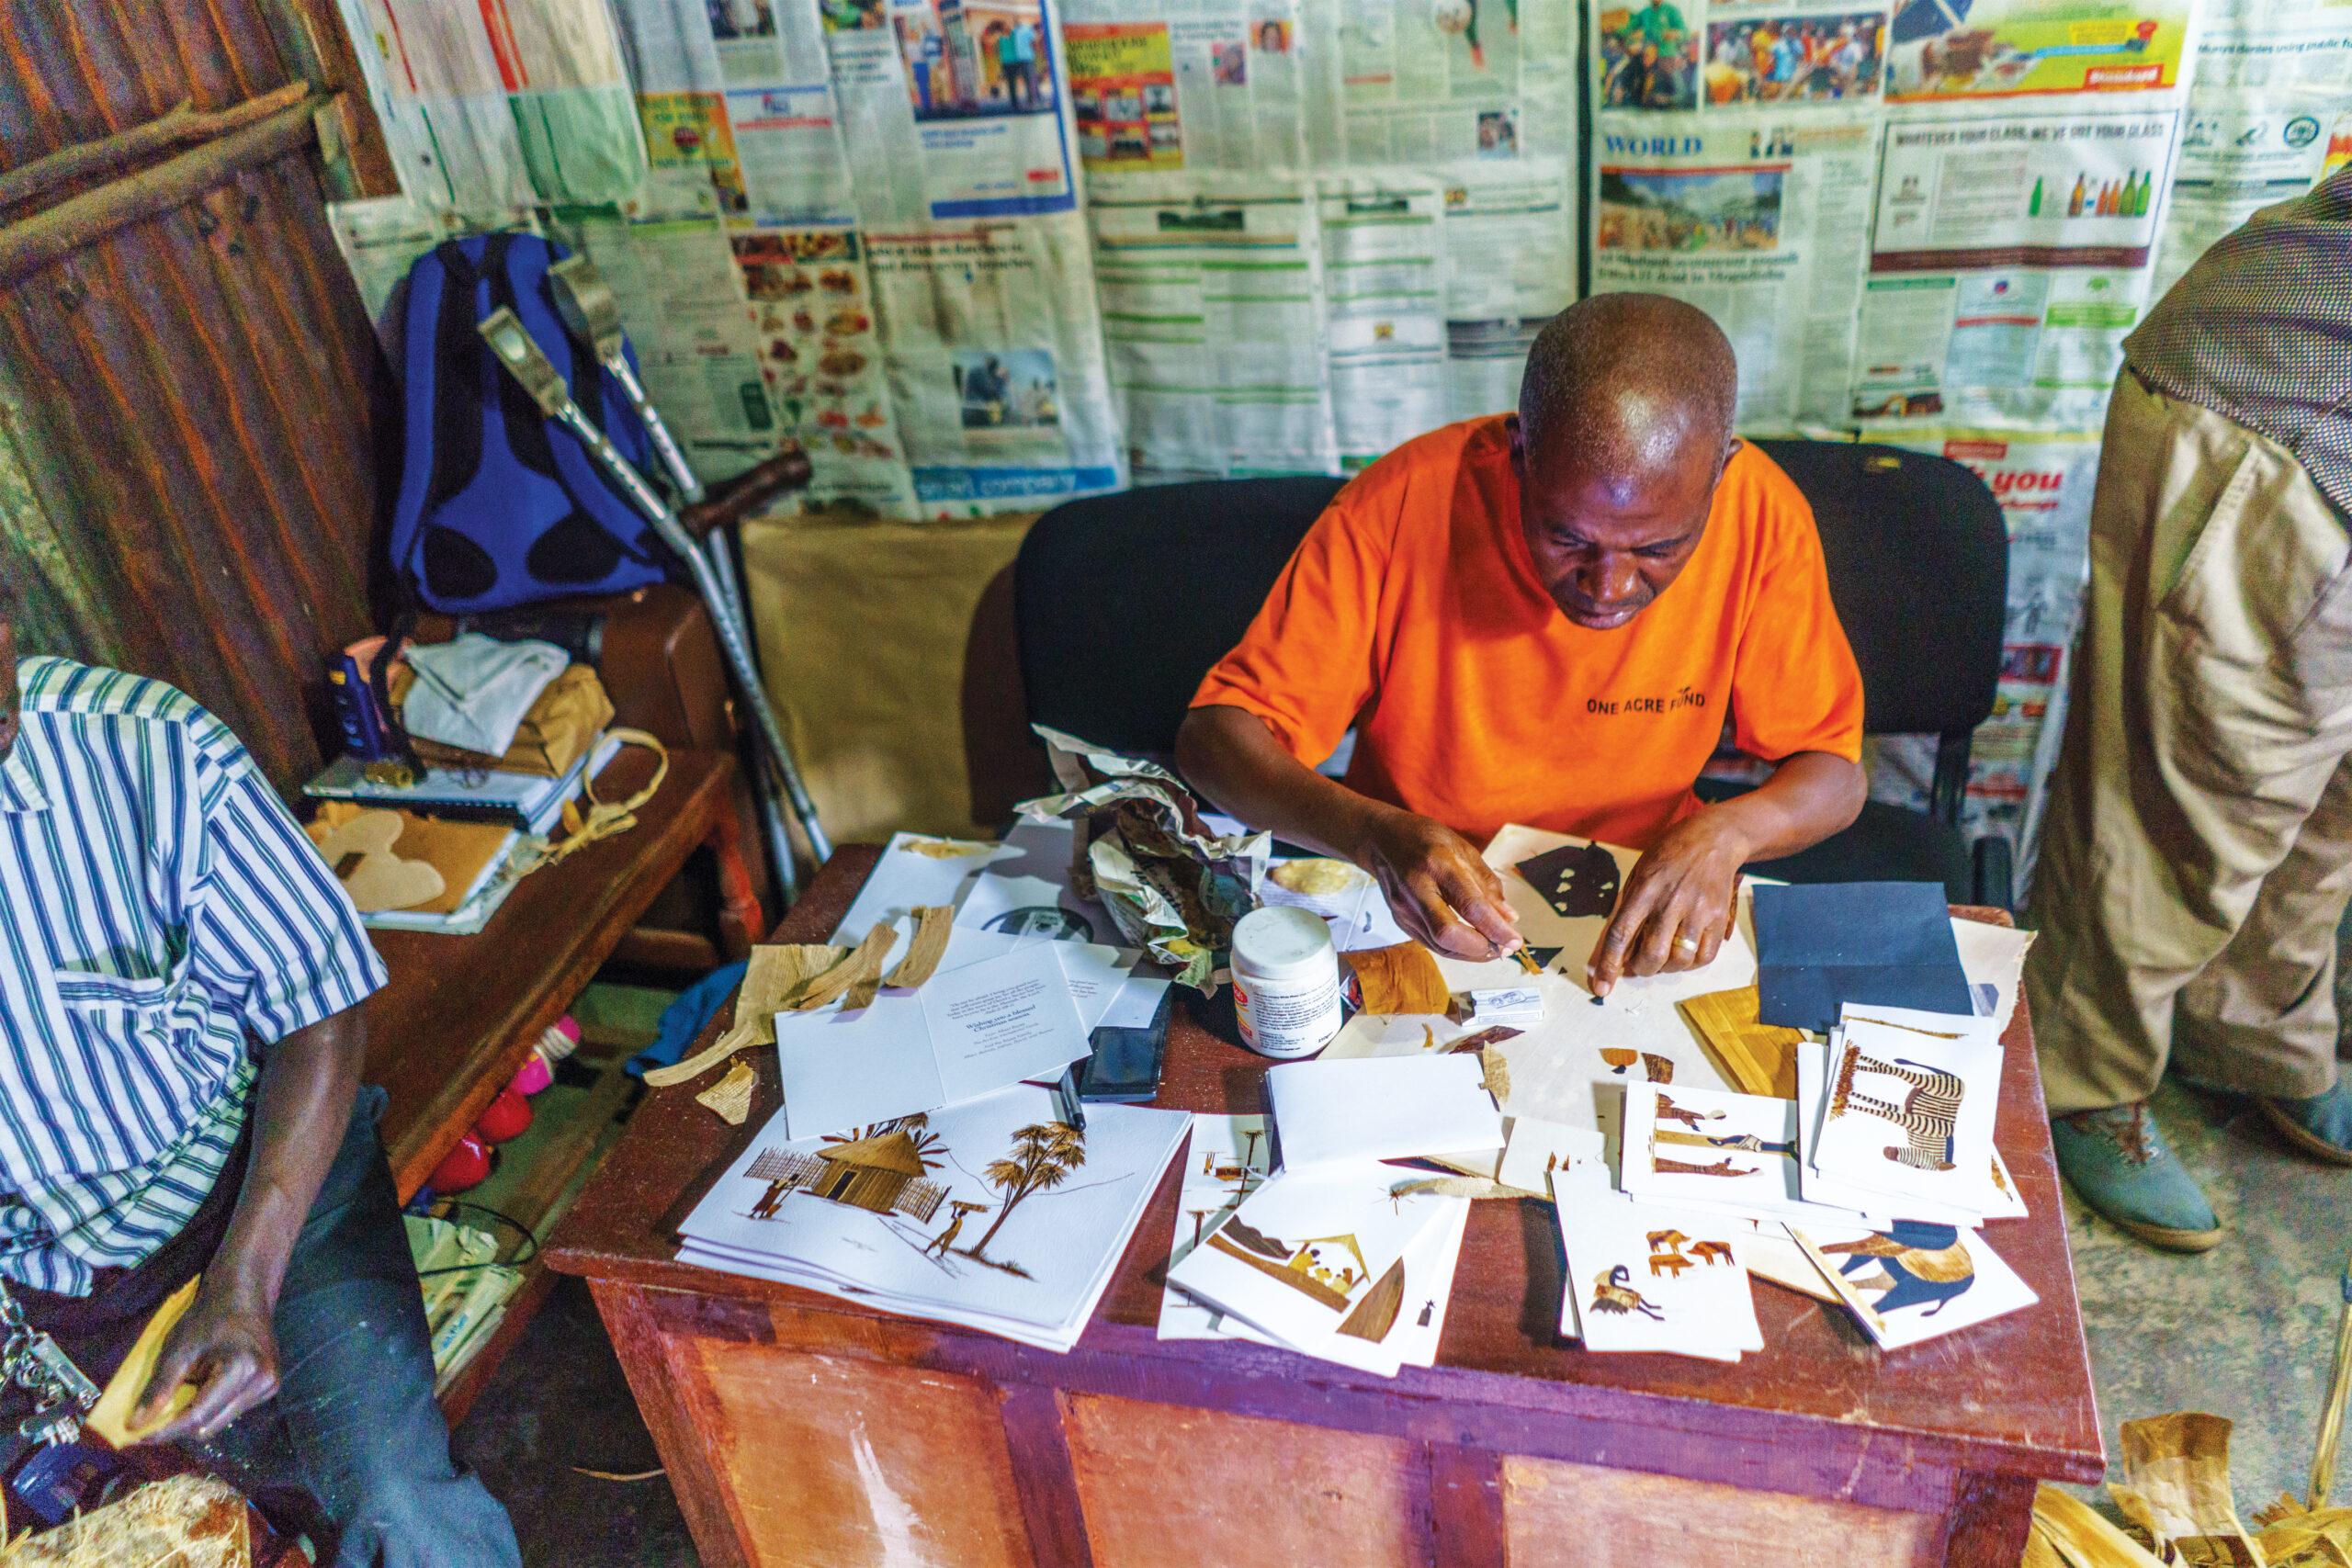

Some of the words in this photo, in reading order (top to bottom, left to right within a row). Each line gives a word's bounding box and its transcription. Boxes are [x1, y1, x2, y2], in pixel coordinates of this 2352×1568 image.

[1604, 135, 1702, 157] WORLD
[1993, 469, 2064, 496] you
[1587, 698, 1620, 715] ONE
[1624, 697, 1666, 714] ACRE
[1669, 693, 1706, 714] FUND
[966, 1018, 993, 1030] Wishing
[1012, 1003, 1036, 1016] blessed
[973, 1020, 1007, 1032] Christmas
